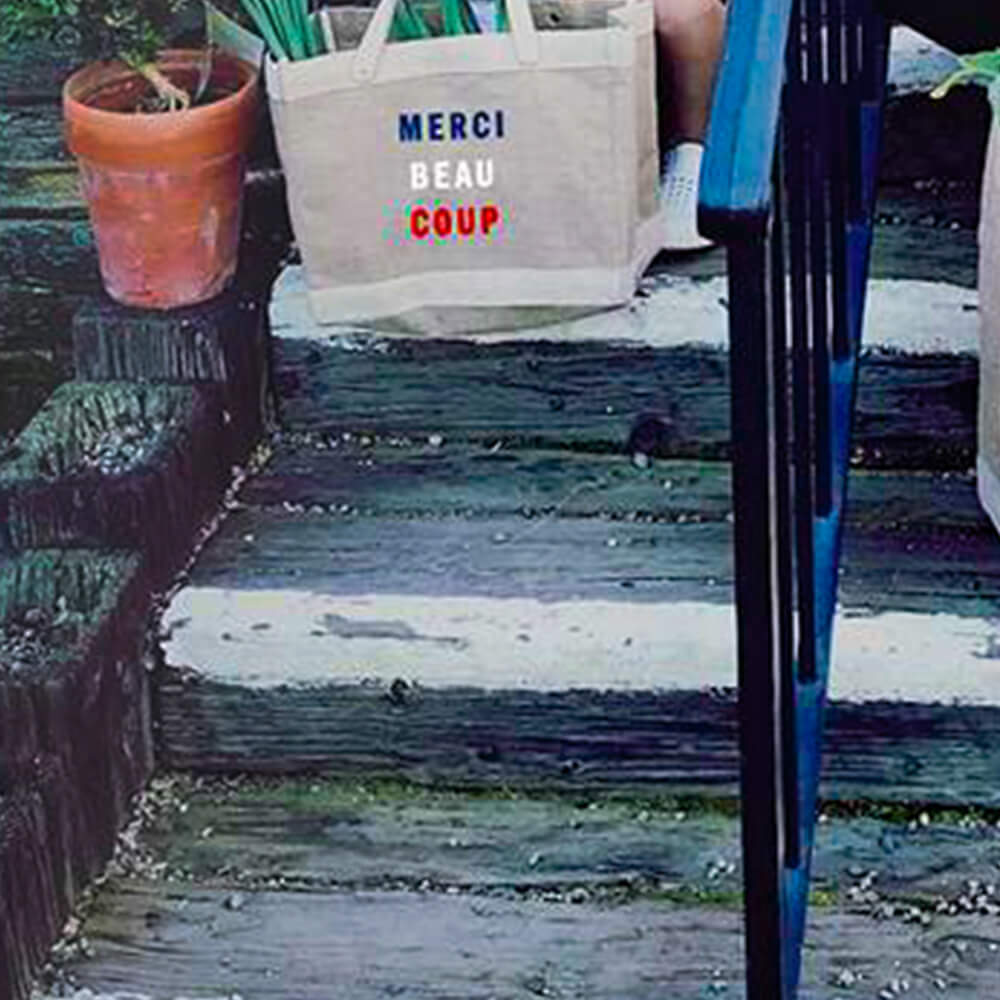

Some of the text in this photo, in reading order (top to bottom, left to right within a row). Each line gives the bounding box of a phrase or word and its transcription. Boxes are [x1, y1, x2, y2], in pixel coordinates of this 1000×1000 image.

[398, 110, 504, 142] MERCI
[410, 159, 494, 190] BEAU
[410, 205, 499, 239] COUP
